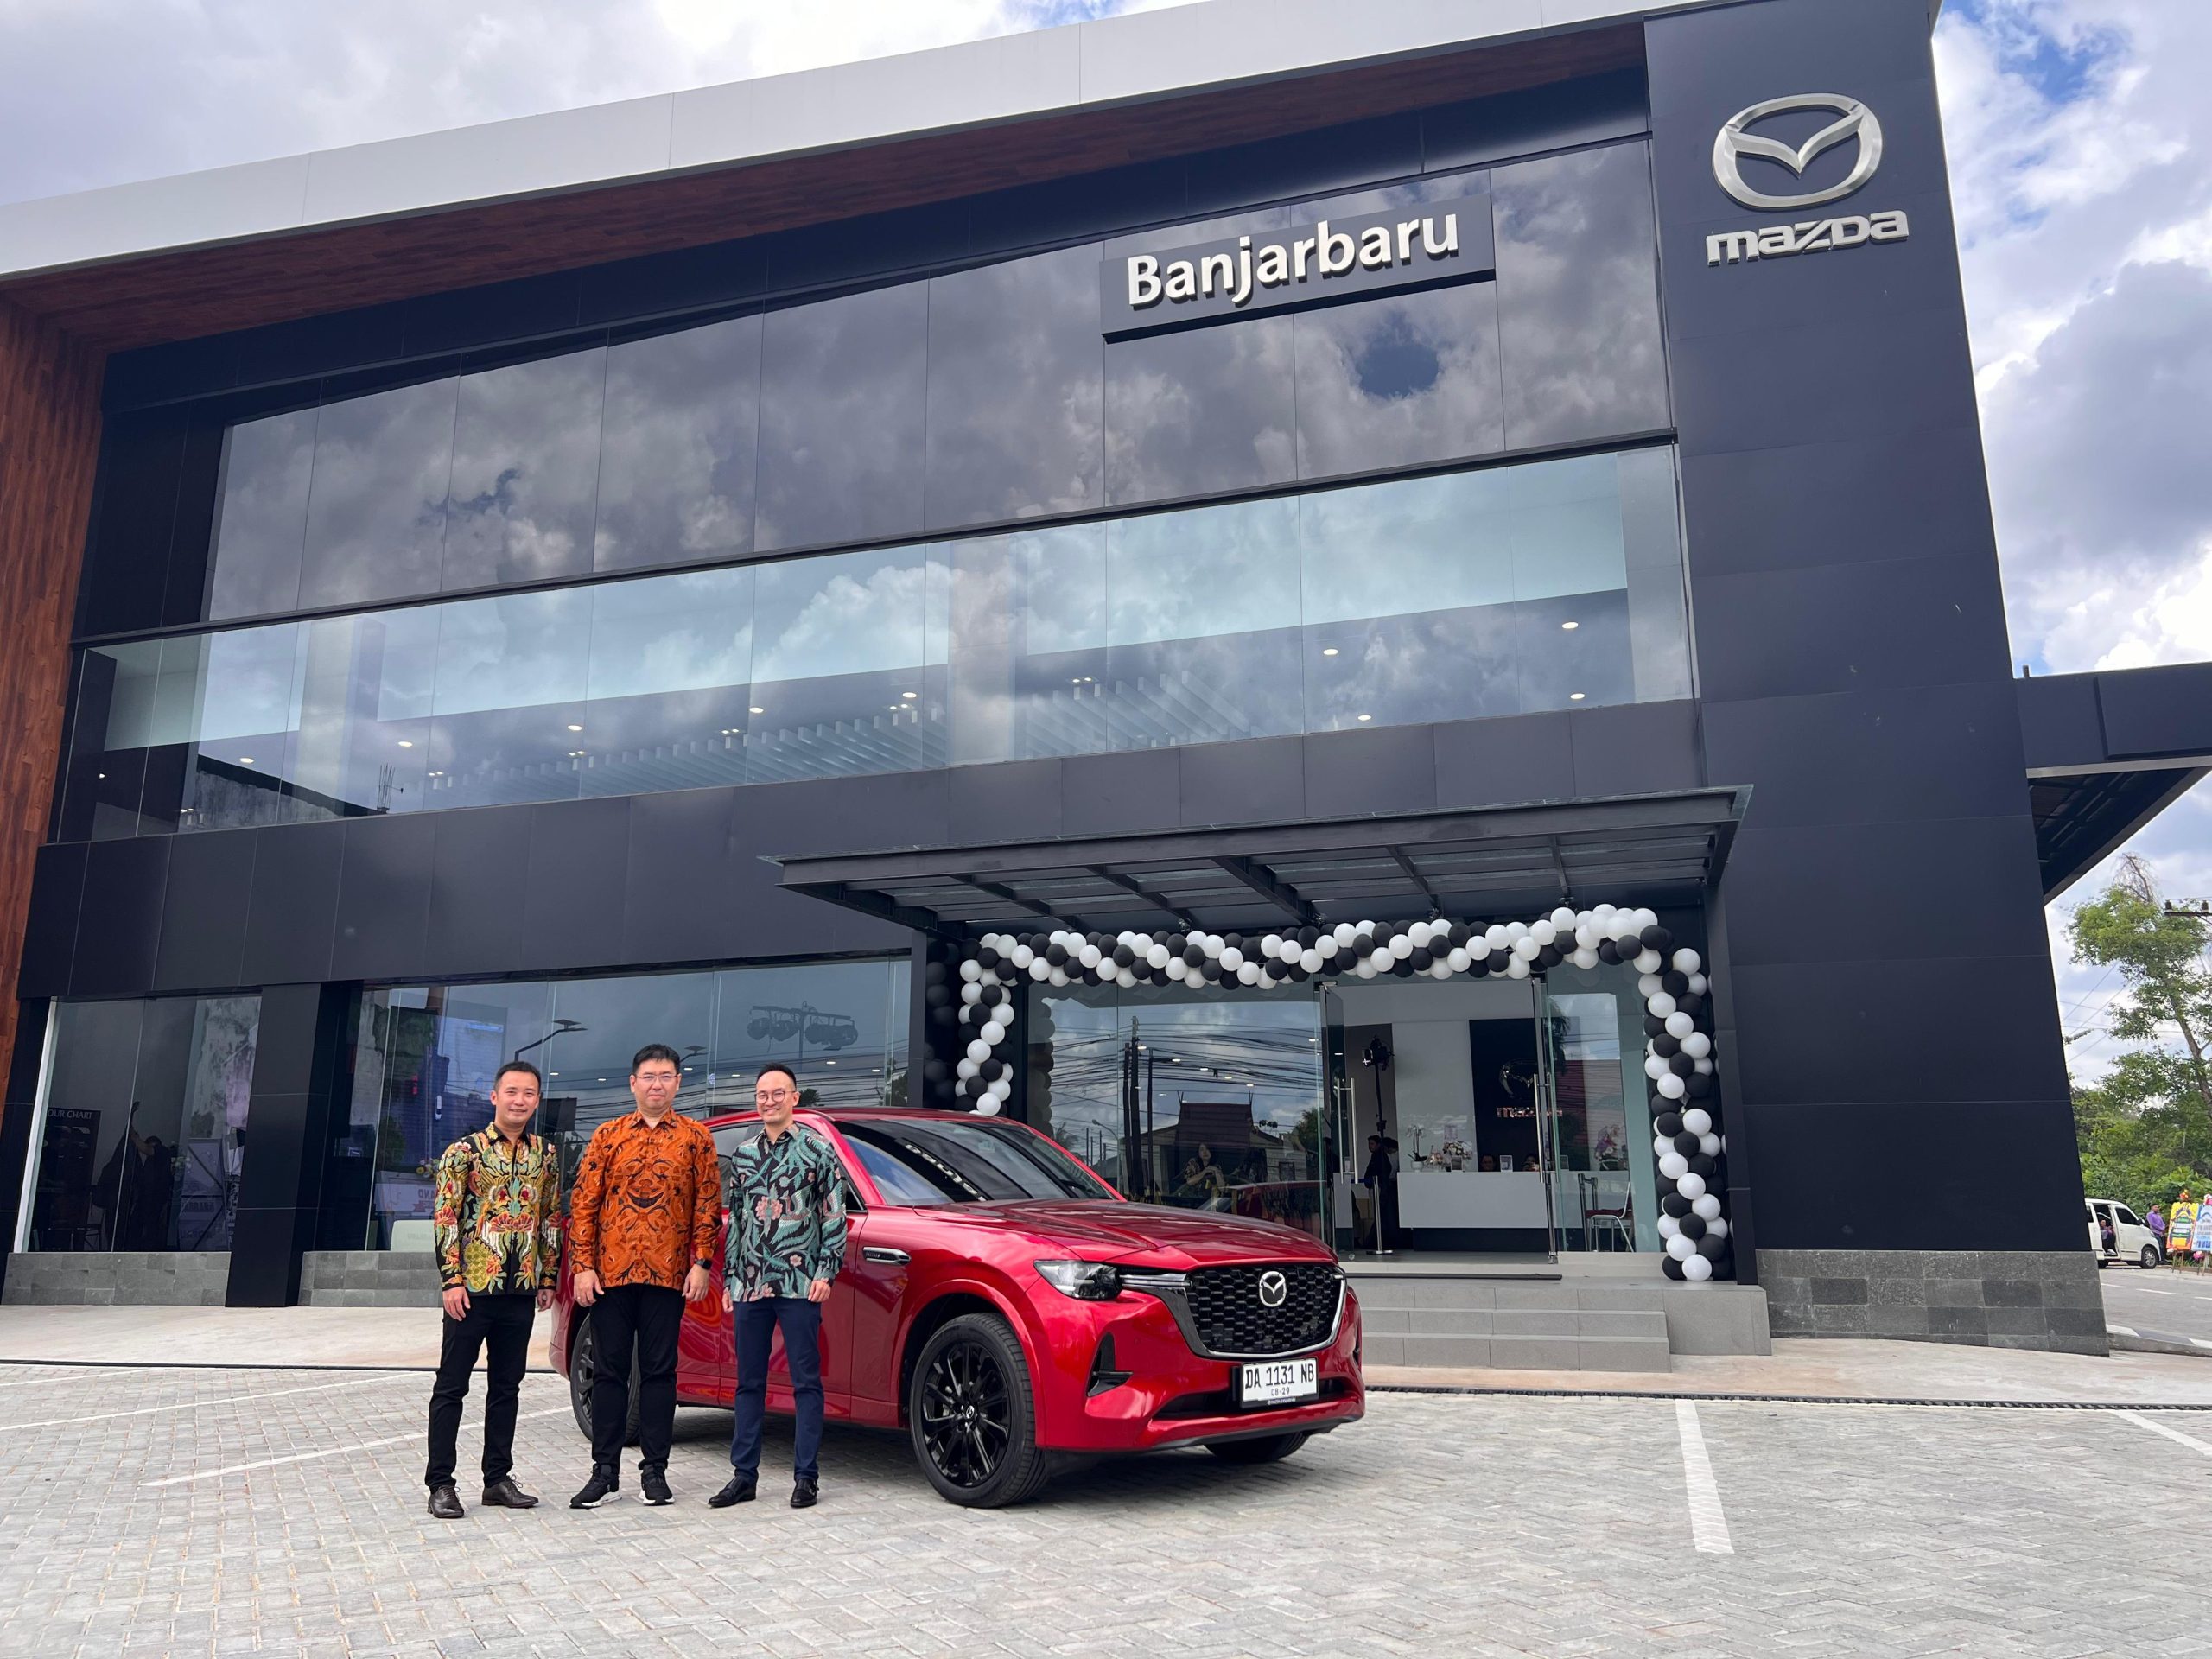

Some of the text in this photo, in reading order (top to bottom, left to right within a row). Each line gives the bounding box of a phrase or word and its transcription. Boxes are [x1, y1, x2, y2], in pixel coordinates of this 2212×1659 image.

[1706, 210, 1909, 266] mazda
[1128, 213, 1459, 308] Banjarbaru
[67, 1109, 92, 1120] CHART
[1245, 1363, 1314, 1389] DA 1131 NB
